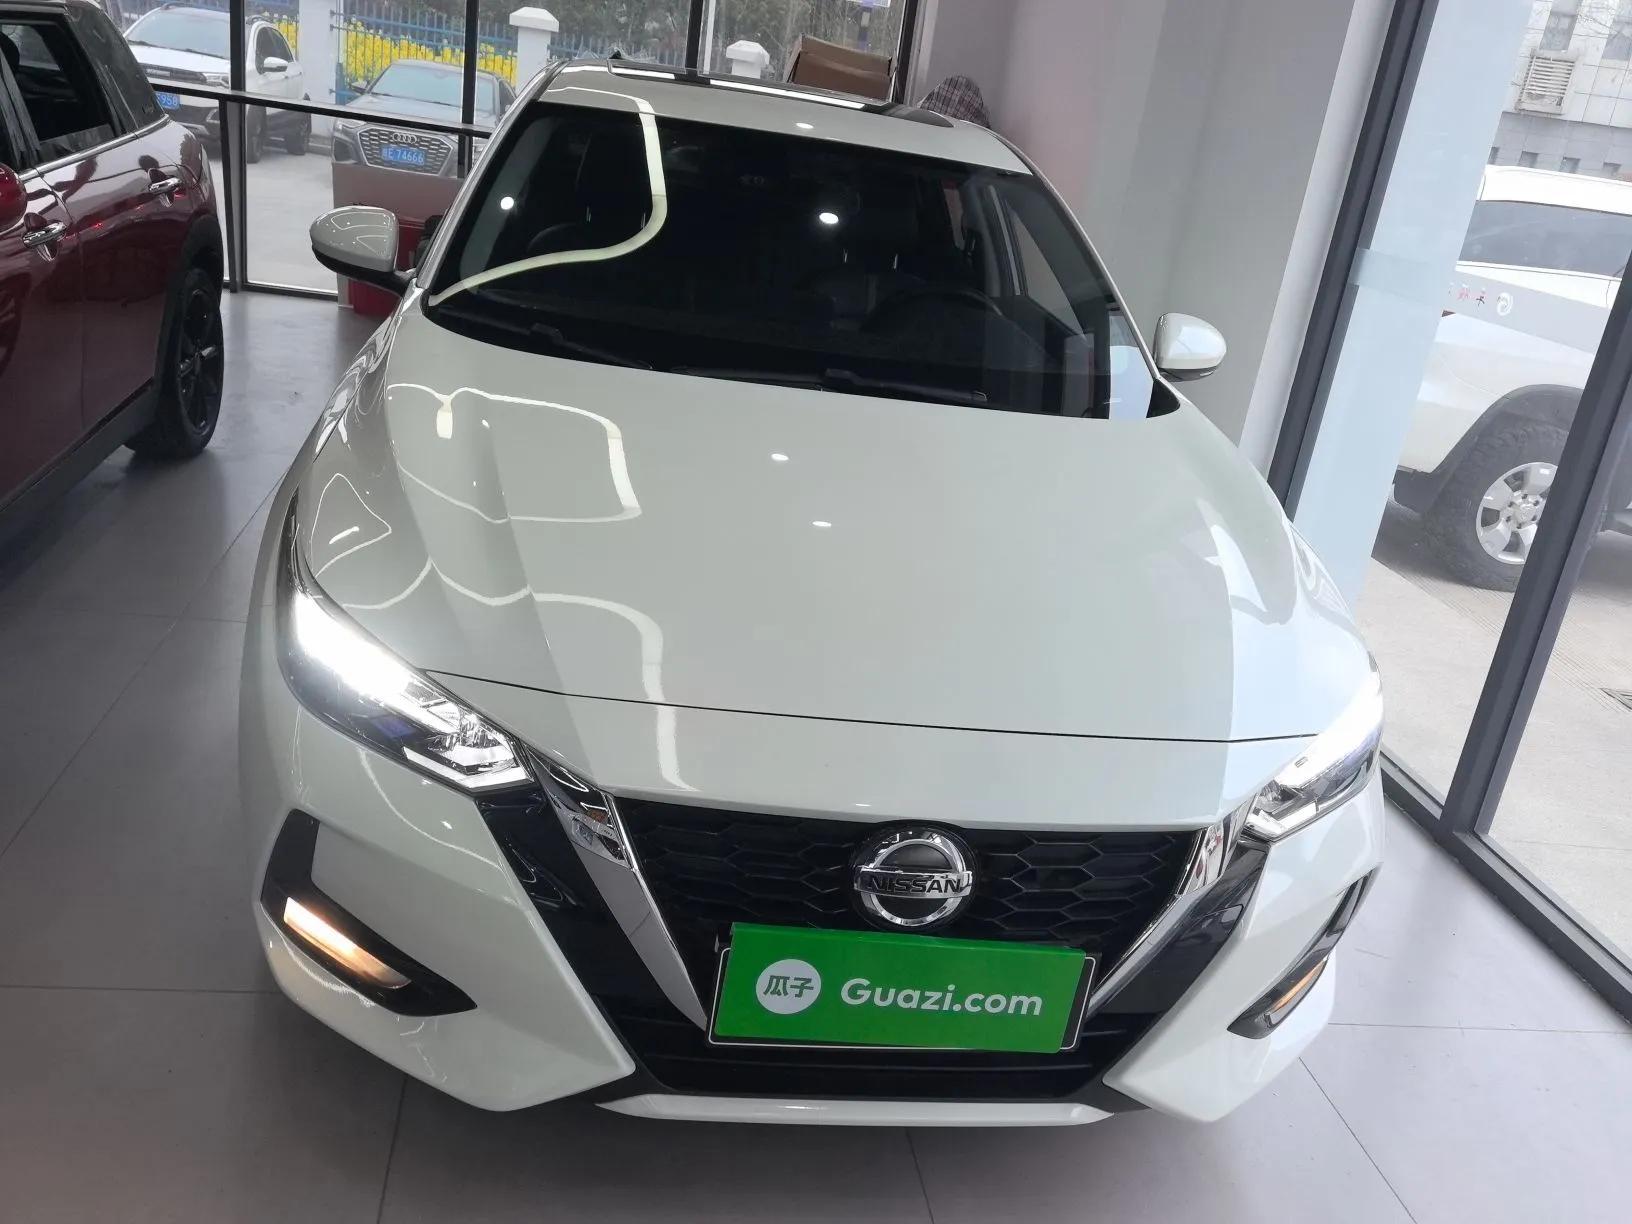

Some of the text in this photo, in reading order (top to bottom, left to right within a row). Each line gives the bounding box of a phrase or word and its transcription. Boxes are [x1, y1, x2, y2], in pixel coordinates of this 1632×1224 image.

[868, 876, 963, 894] NISSAN
[763, 974, 815, 999] 瓜子
[840, 977, 1043, 1016] Guazi.com
